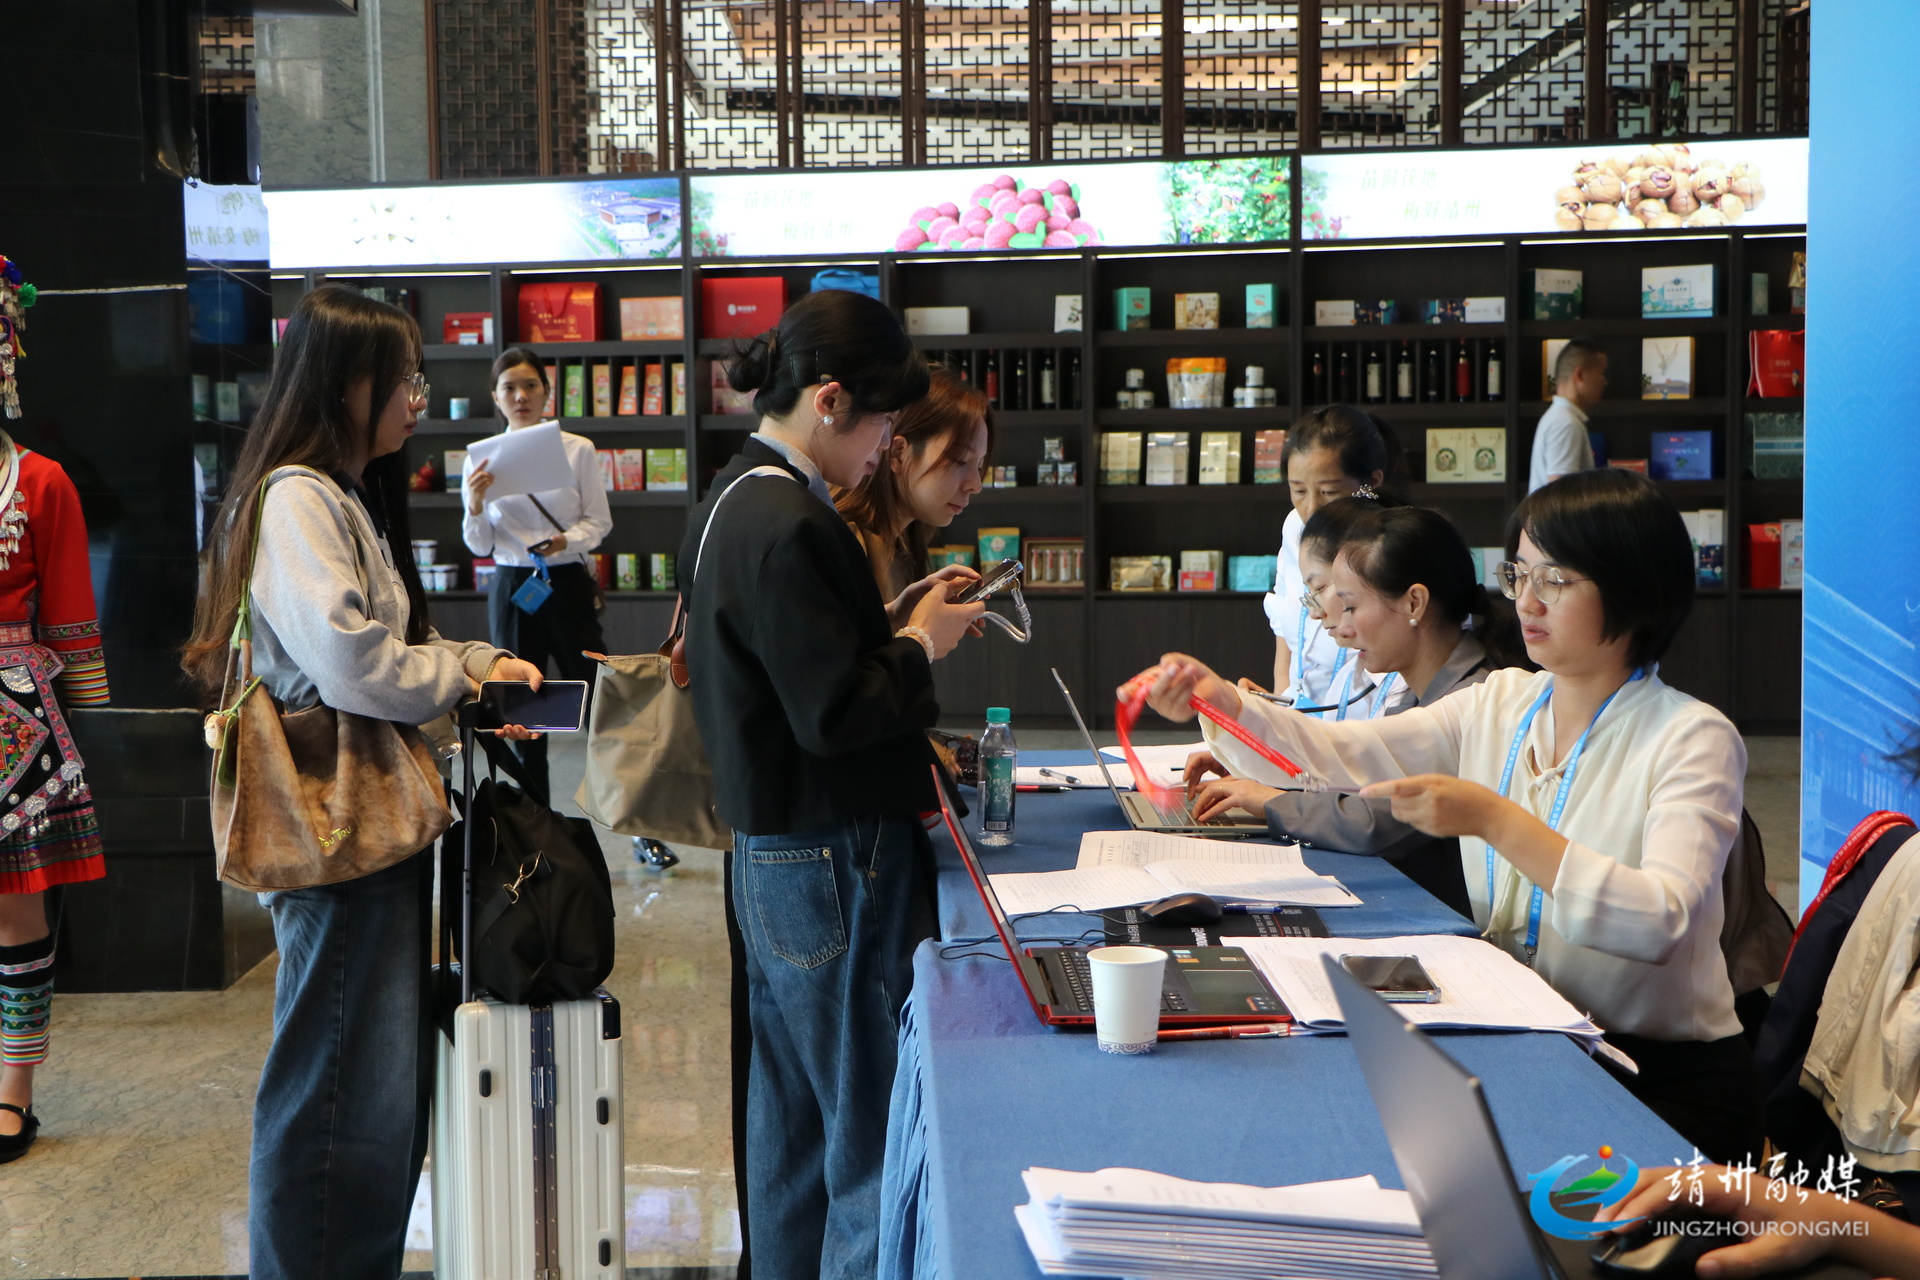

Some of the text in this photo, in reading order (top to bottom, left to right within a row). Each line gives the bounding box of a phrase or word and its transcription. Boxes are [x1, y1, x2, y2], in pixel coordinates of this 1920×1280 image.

[1549, 742, 1582, 829] 2025第四届全国茯苓大会暨
